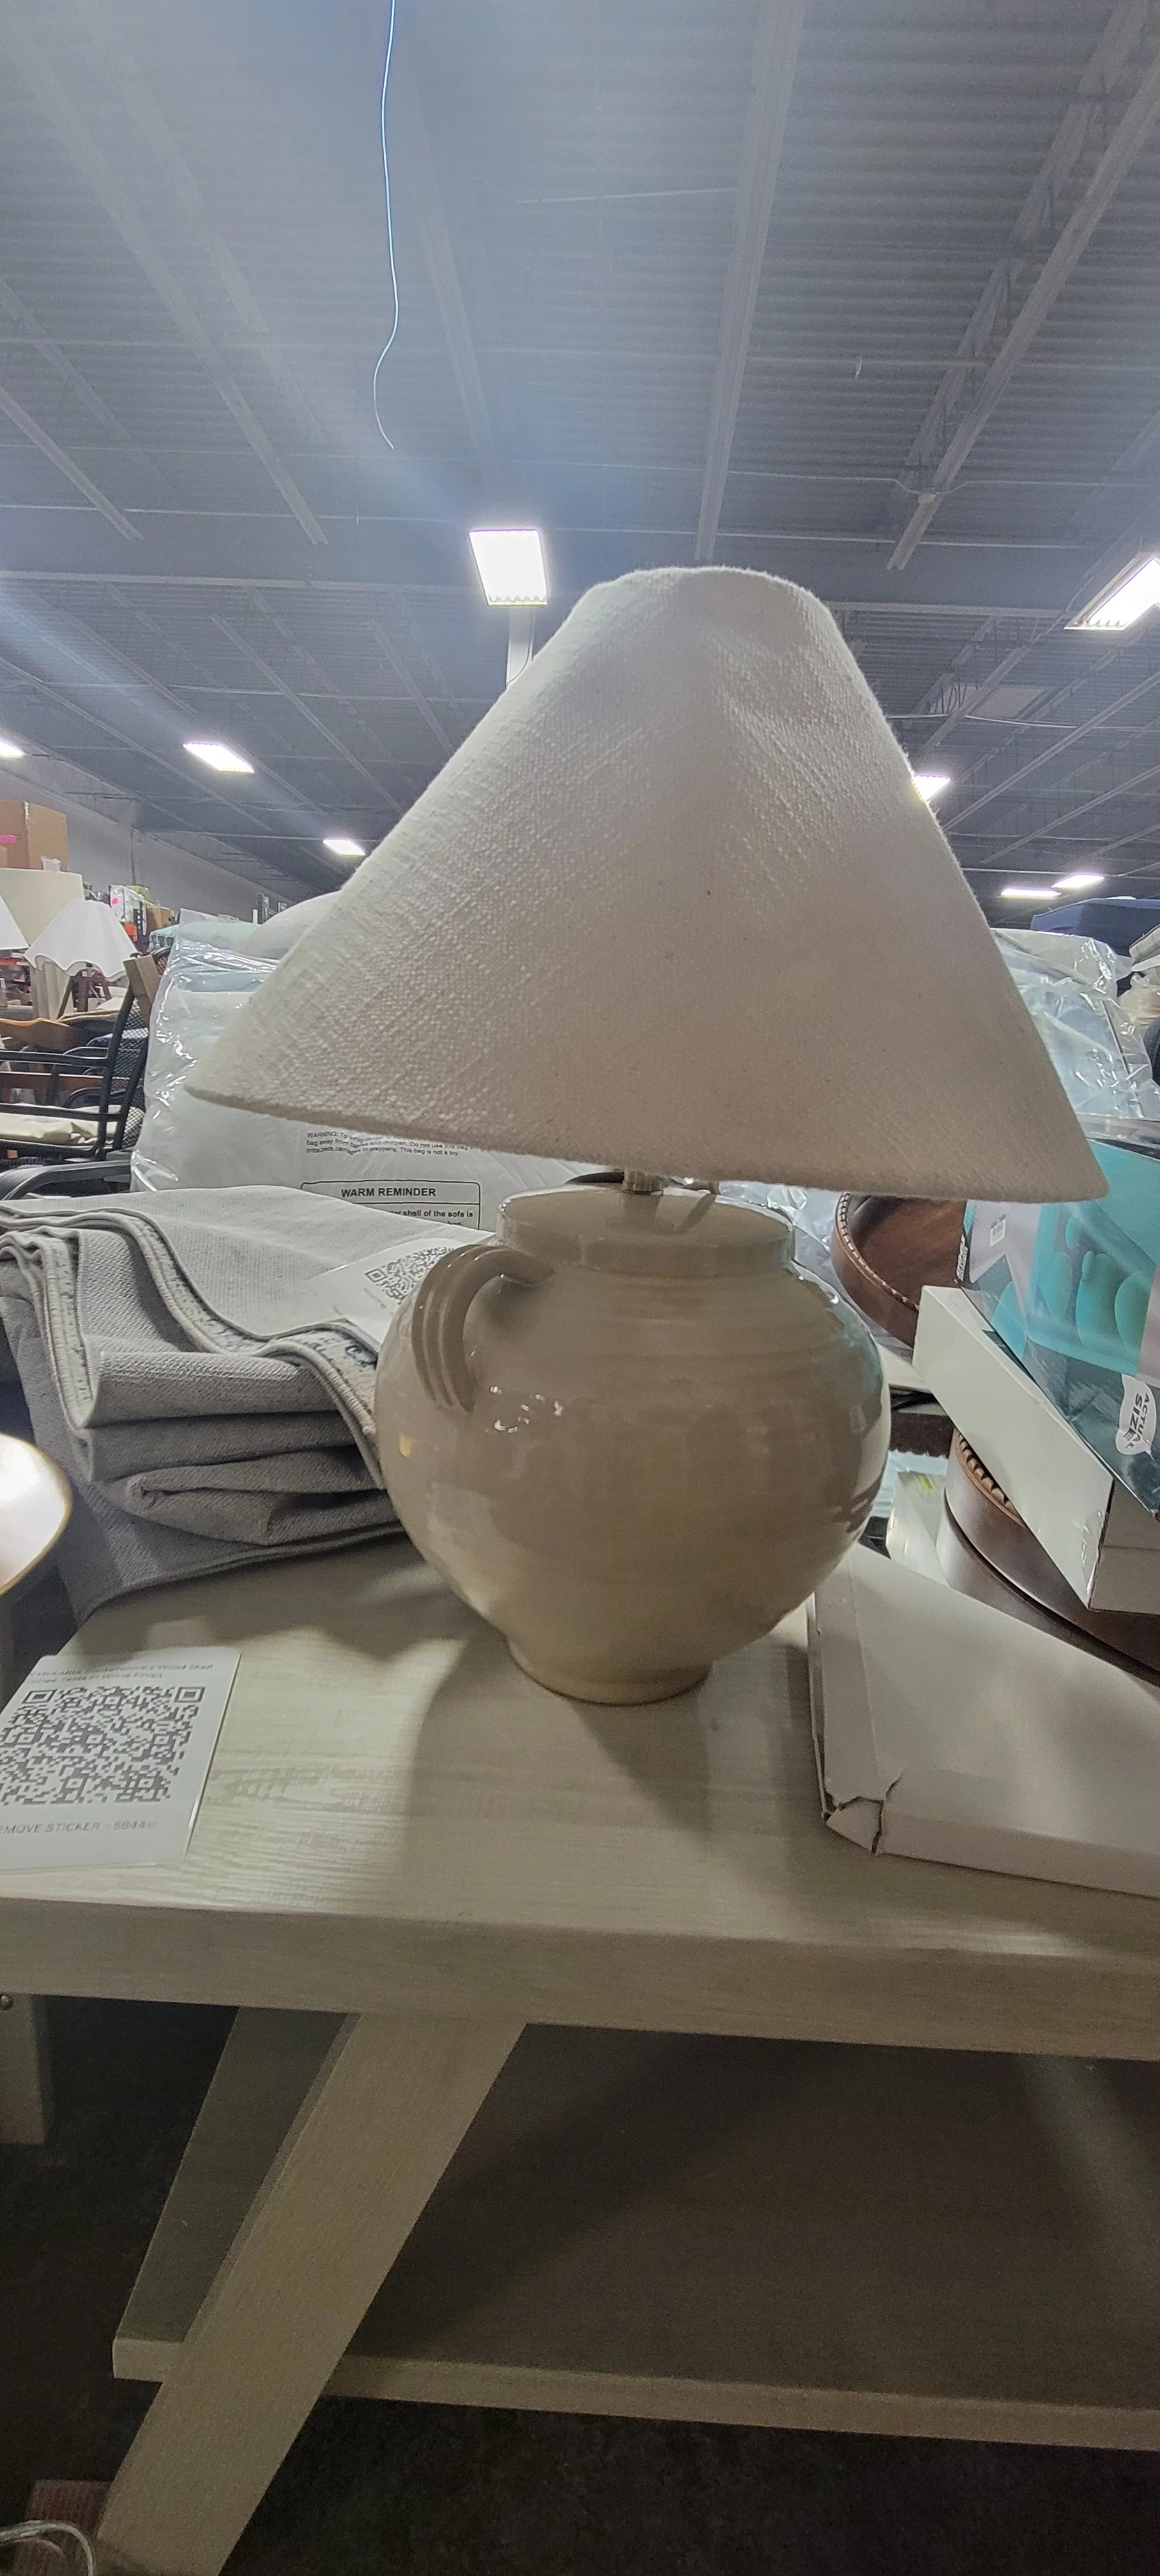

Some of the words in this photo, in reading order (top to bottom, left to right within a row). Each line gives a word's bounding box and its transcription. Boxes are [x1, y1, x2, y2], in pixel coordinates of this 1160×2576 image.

[341, 1188, 375, 1198] WARM
[378, 1188, 436, 1197] REMINDER
[1123, 1392, 1143, 1441] SIZE
[1125, 1392, 1150, 1449] ACTUAL
[45, 1821, 100, 1833] STICKER
